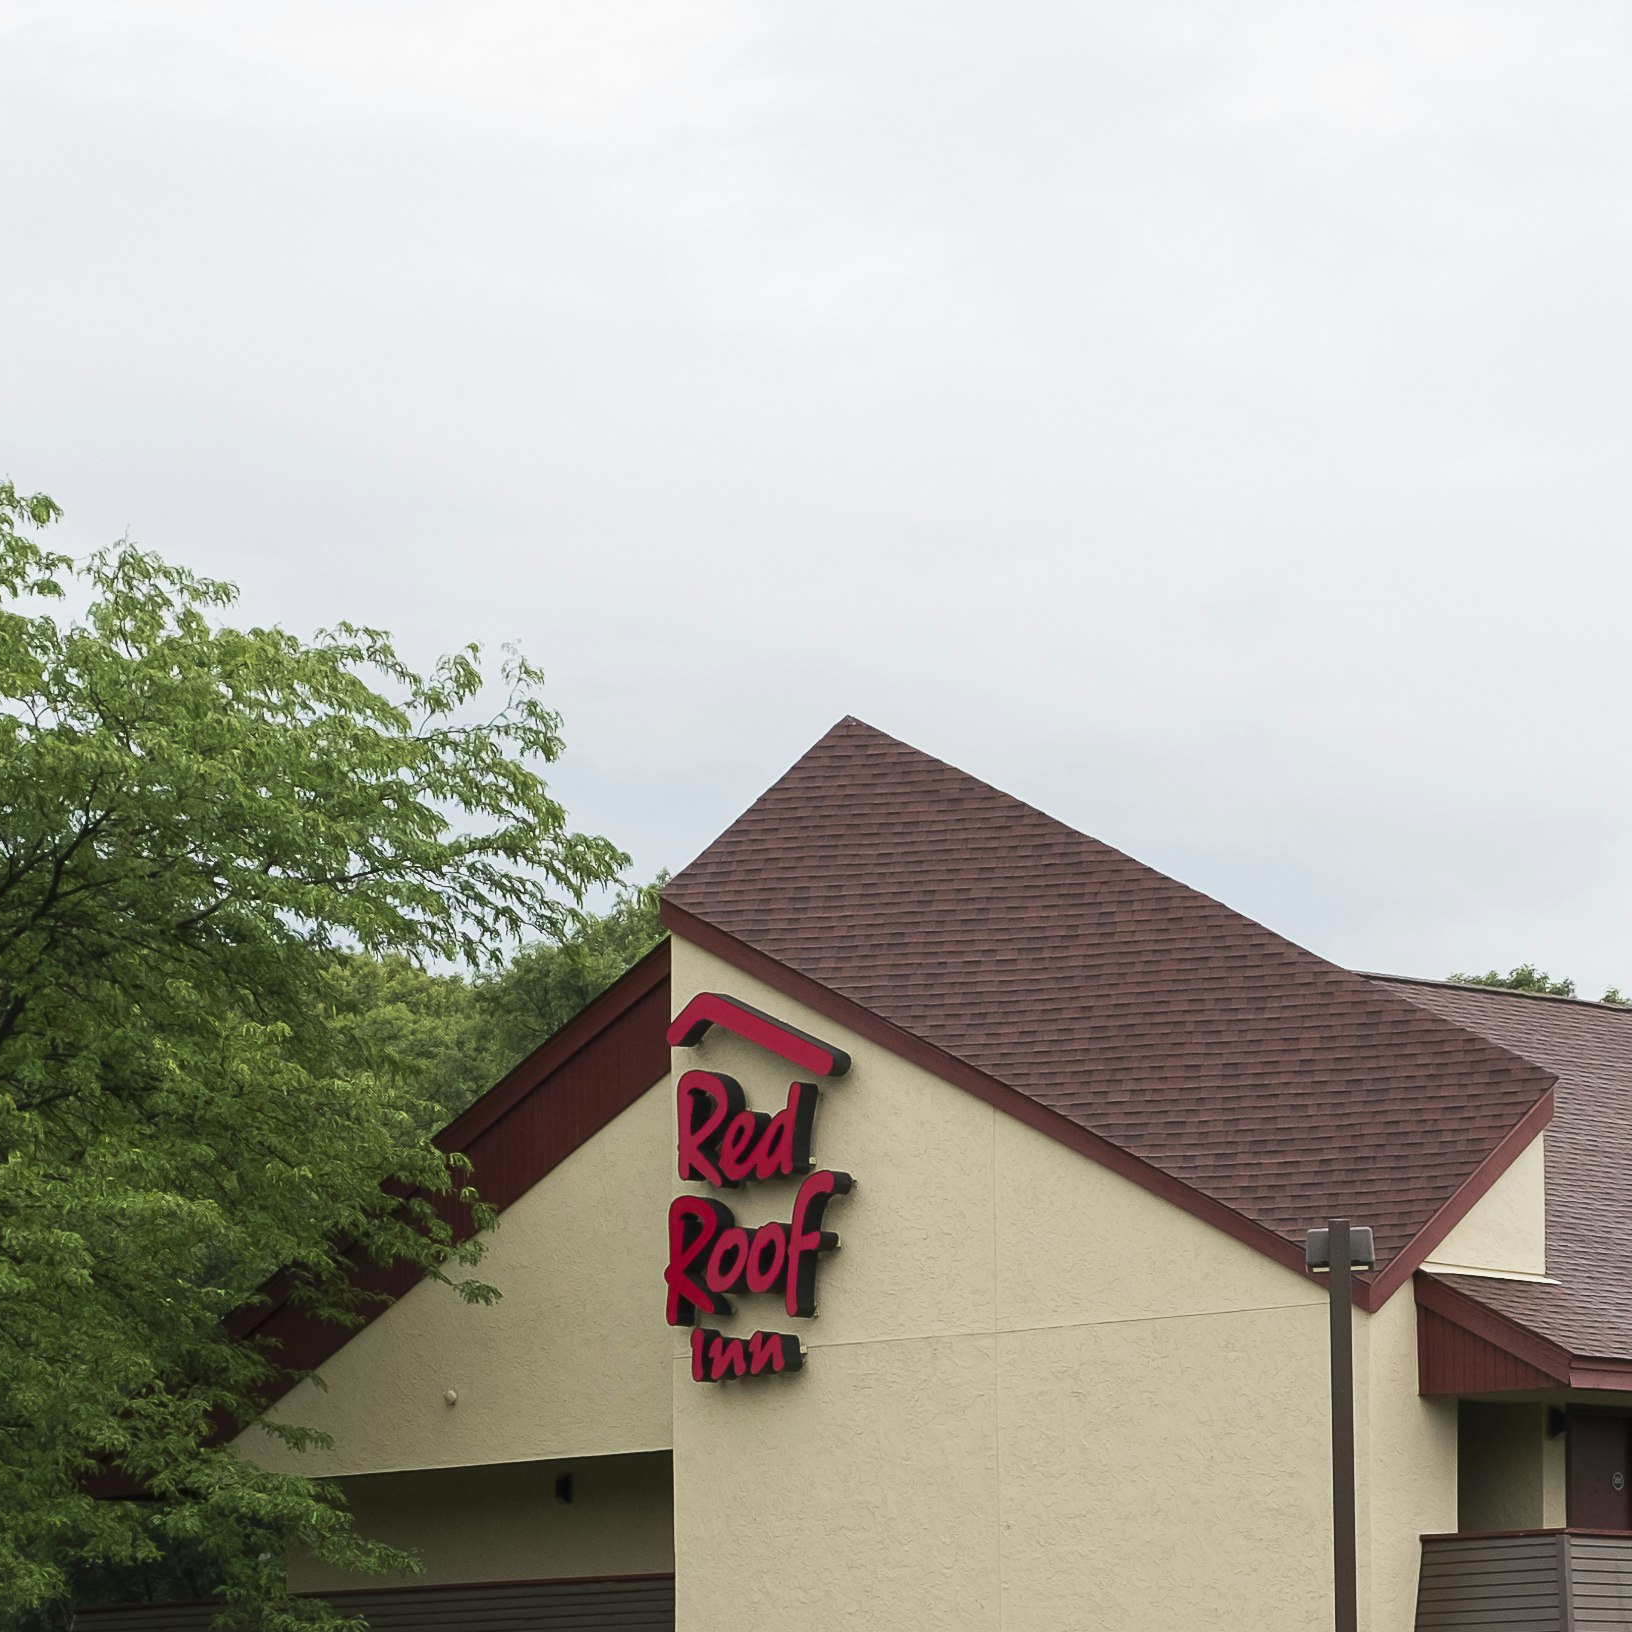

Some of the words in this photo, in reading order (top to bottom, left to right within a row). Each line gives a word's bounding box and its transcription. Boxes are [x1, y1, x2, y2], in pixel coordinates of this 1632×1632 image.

[677, 1069, 804, 1188] Red
[664, 1170, 836, 1326] Roof
[690, 1327, 788, 1382] Inn
